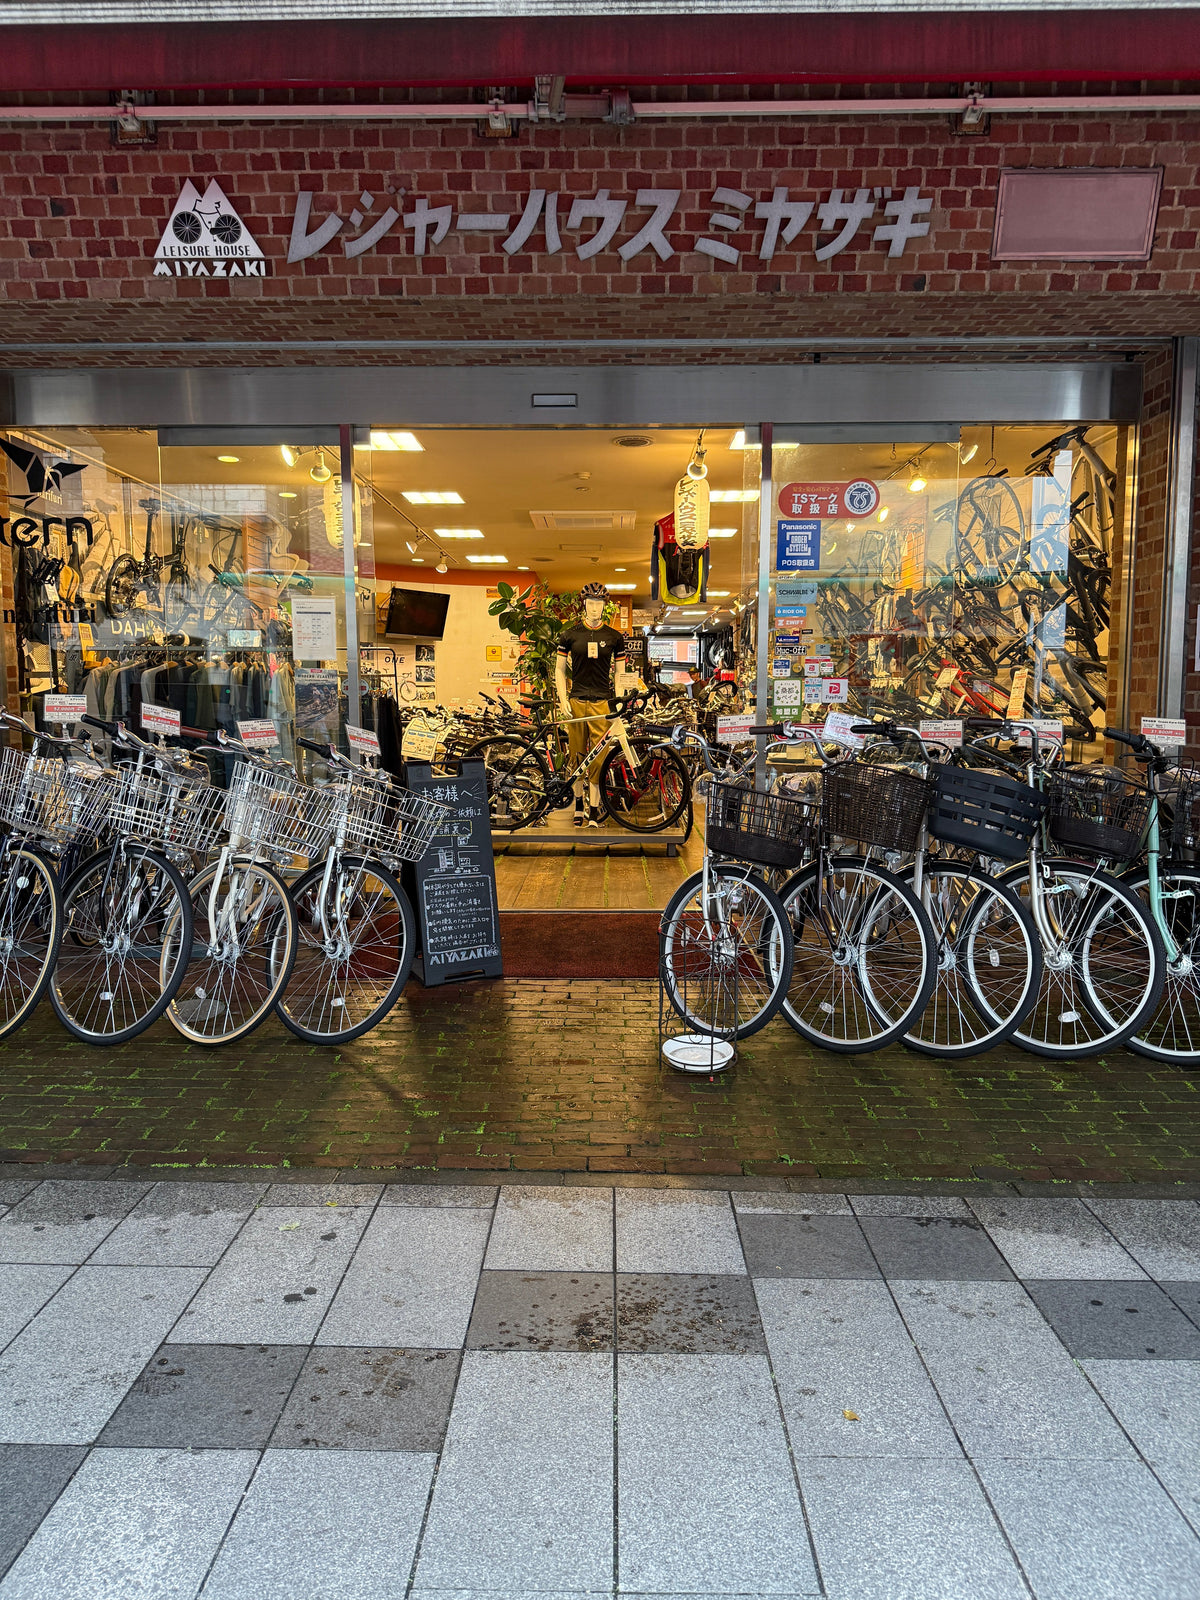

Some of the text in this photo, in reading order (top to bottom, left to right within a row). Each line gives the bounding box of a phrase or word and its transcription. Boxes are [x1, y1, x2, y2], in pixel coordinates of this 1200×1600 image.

[286, 185, 934, 266] レジャーハウス ミヤザキ
[162, 244, 251, 257] LEISURE HOUSE
[152, 260, 266, 277] MIYAZAKI
[792, 493, 838, 504] TSマーク
[0, 514, 93, 547] tern
[791, 535, 808, 544] ORDER
[789, 543, 809, 552] SYSTEM
[776, 646, 805, 654] Muc-Off
[574, 730, 613, 775] TREK
[430, 947, 488, 965] MIYAZAKI
